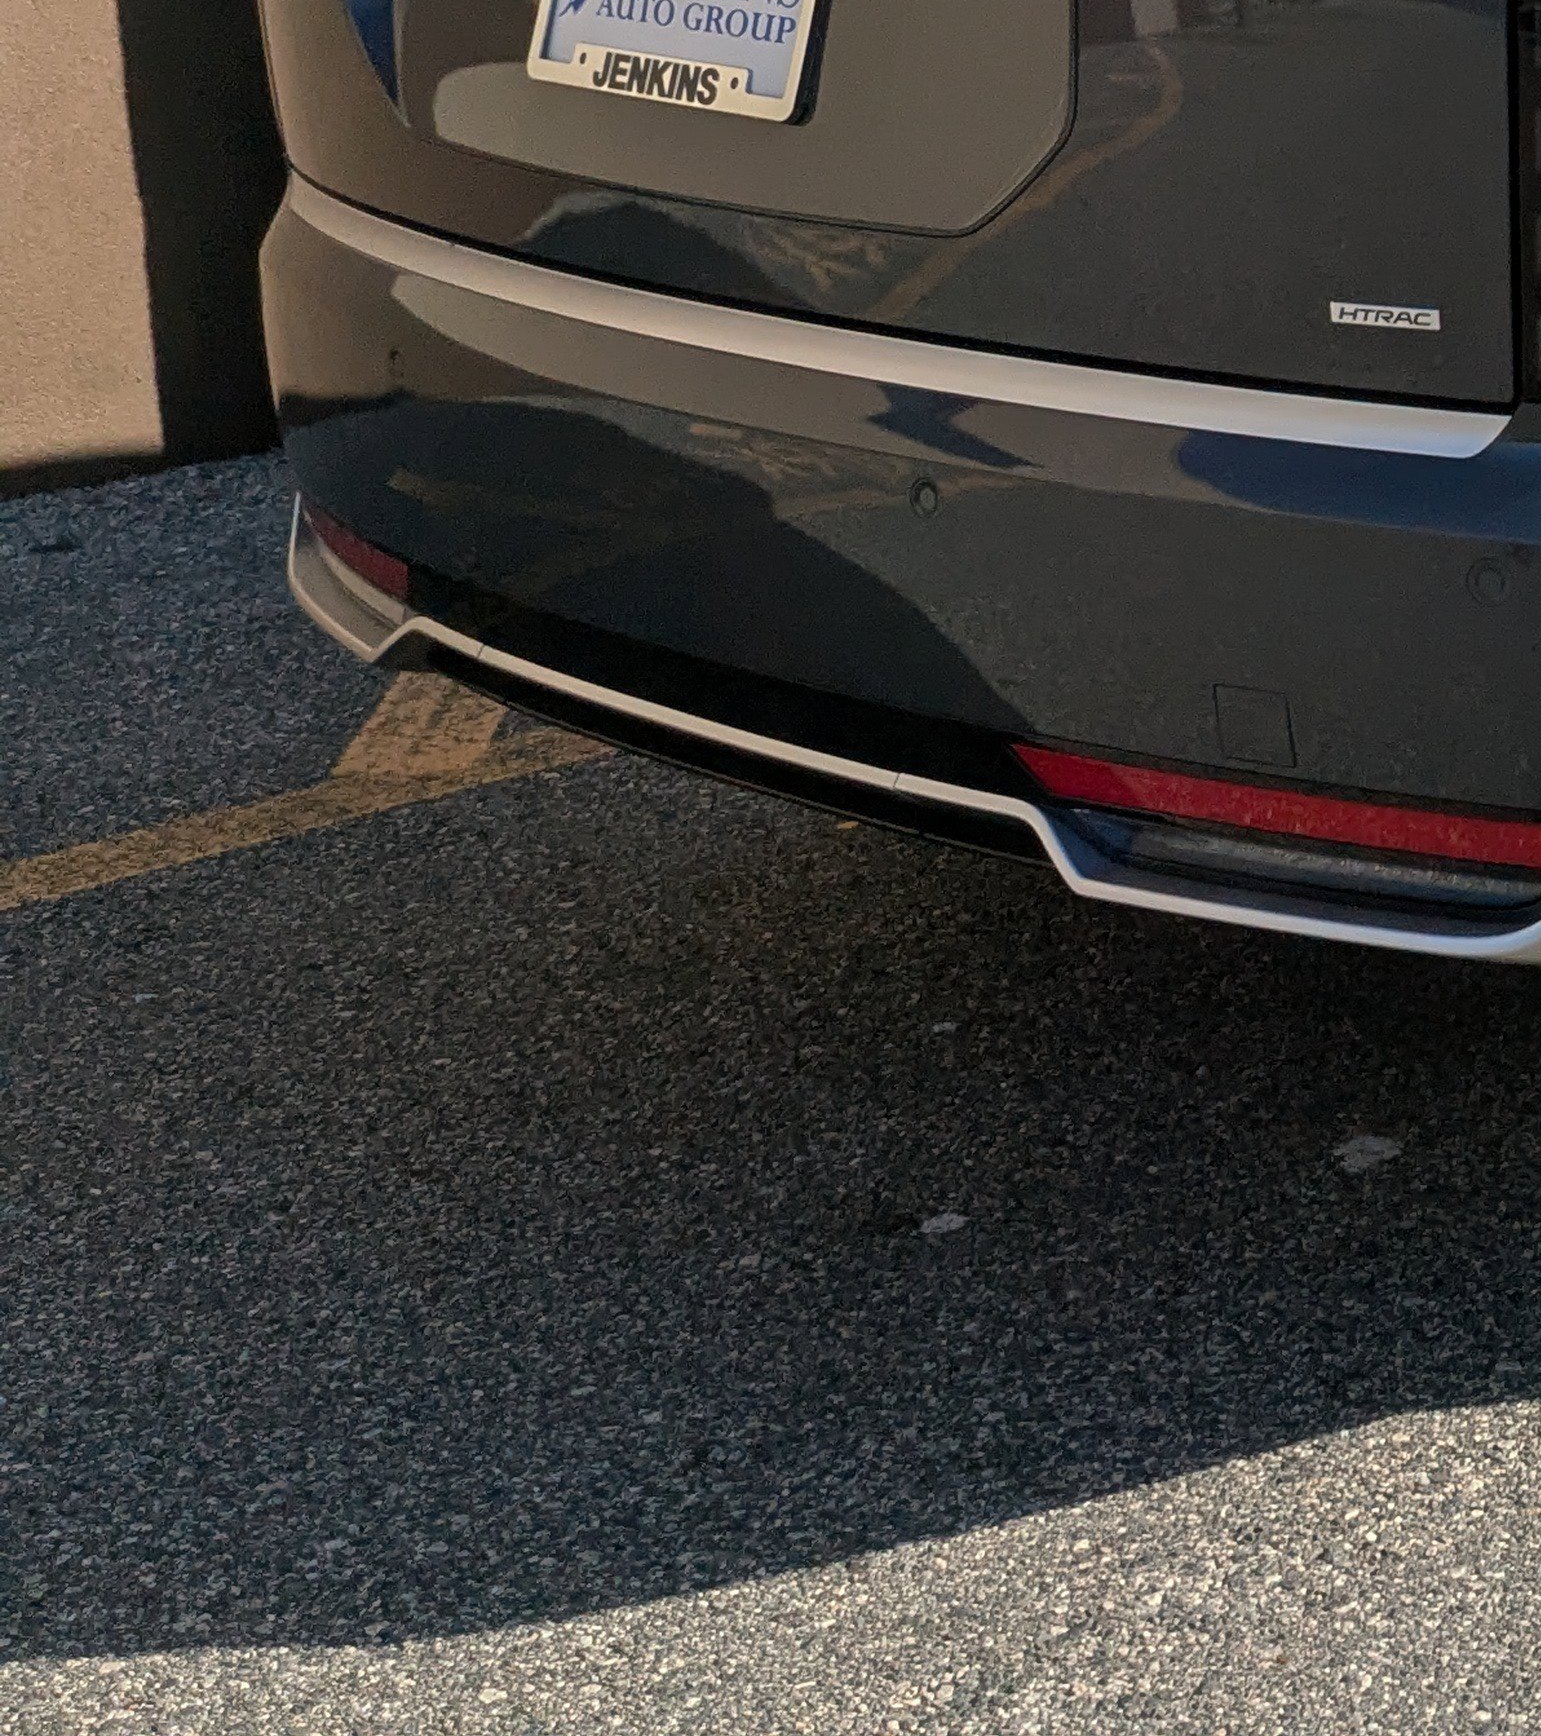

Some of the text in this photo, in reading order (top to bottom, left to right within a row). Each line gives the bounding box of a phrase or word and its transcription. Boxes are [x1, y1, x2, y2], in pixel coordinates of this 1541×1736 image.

[682, 2, 797, 45] GROUP
[591, 51, 720, 106] JENKINS
[1338, 306, 1432, 327] HTRAC
